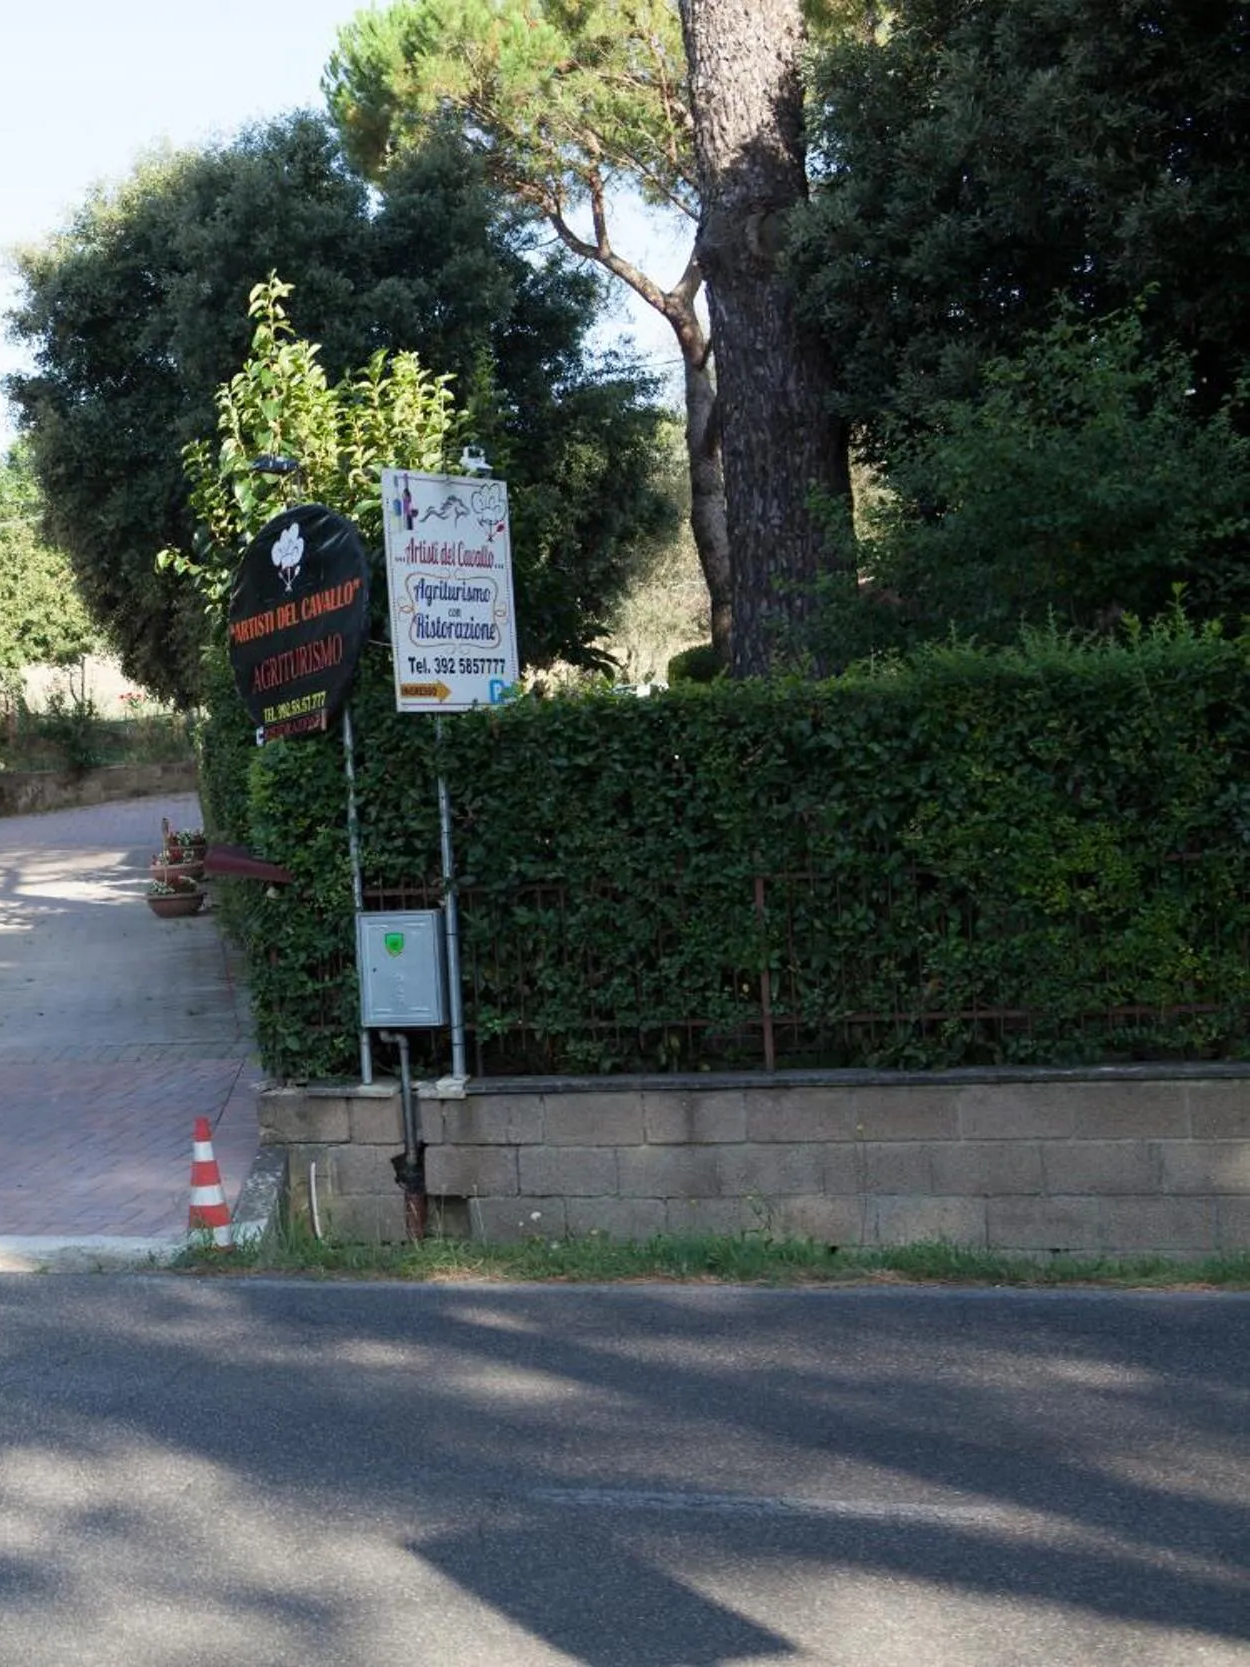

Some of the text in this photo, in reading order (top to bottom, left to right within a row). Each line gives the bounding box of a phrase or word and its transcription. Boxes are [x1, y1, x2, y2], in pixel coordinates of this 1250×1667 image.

[440, 540, 456, 566] del
[413, 578, 491, 607] Agriturismo
[277, 602, 300, 631] DEL
[414, 613, 496, 640] Ristorazione
[448, 608, 462, 618] con
[252, 633, 343, 693] AGRITURISMO
[408, 656, 506, 674] Tel. 392 5857777
